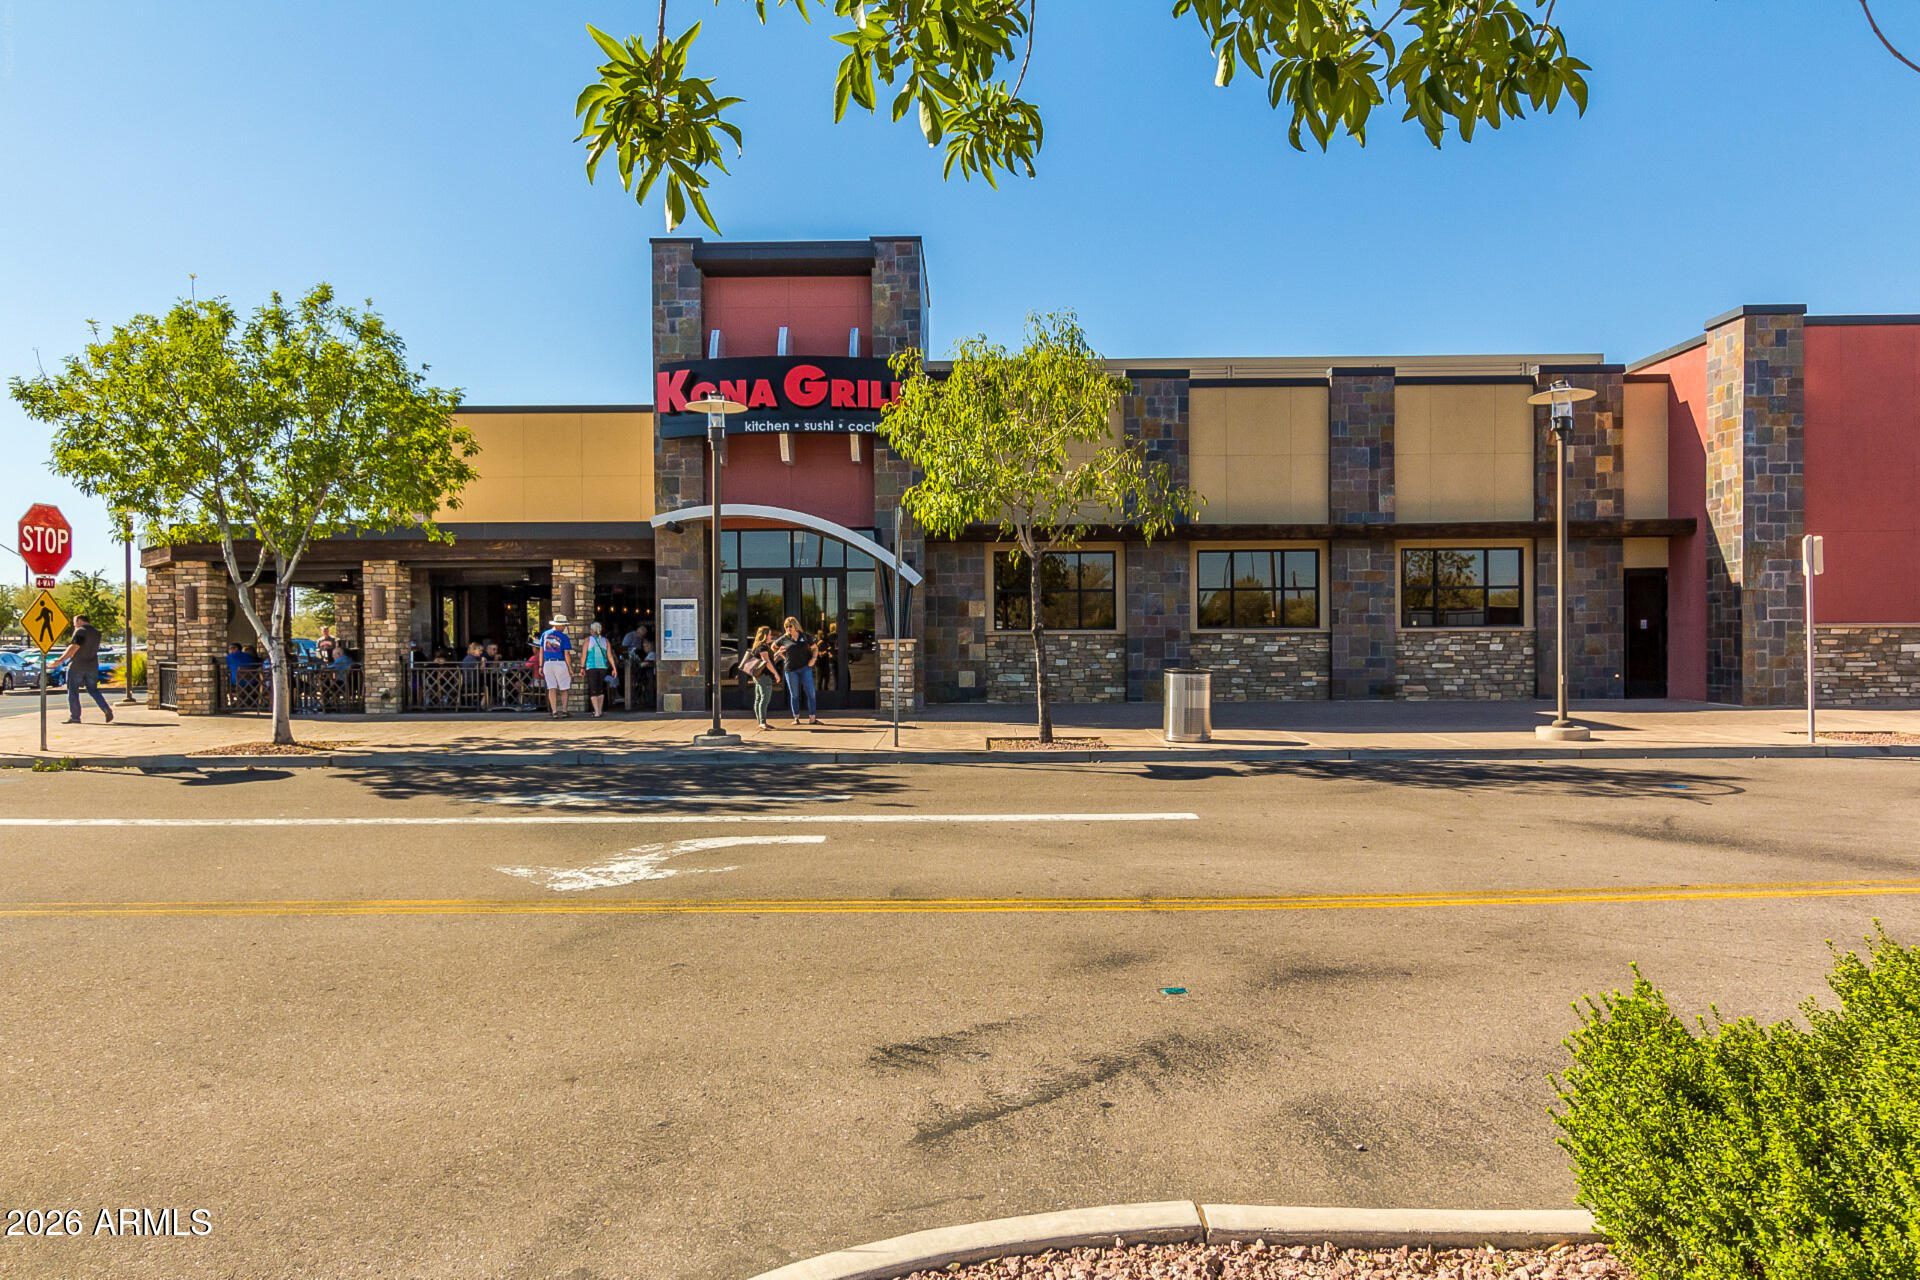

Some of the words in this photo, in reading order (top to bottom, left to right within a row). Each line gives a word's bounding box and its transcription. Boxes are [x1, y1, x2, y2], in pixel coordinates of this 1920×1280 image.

[657, 369, 778, 413] KONA
[744, 420, 790, 432] kitchen
[804, 420, 834, 431] sushi
[21, 525, 69, 554] STOP
